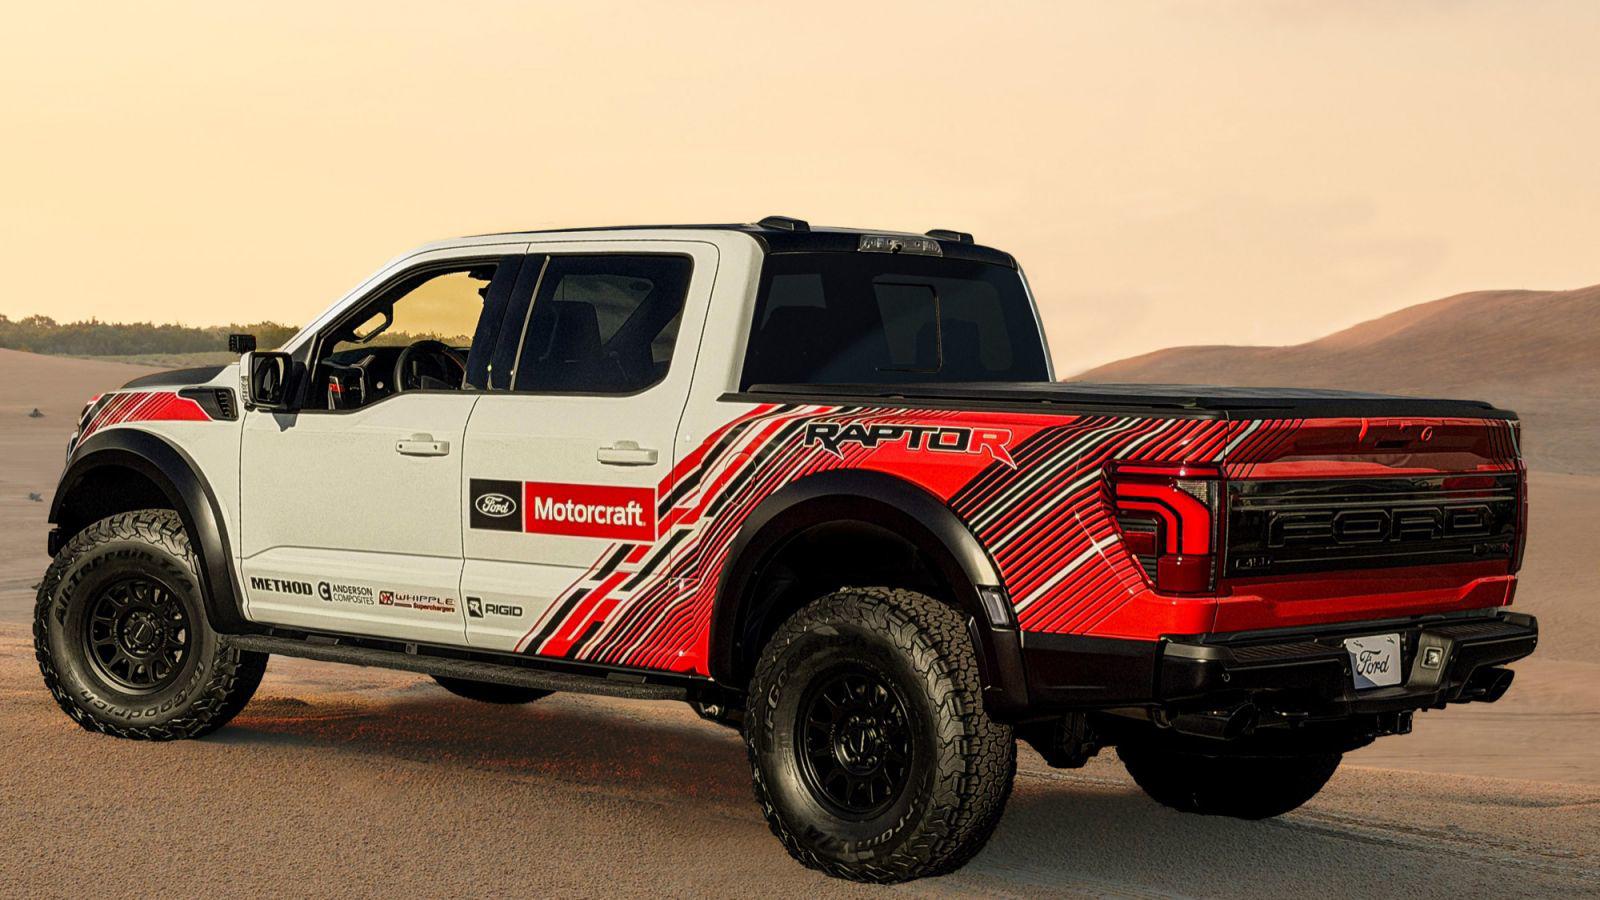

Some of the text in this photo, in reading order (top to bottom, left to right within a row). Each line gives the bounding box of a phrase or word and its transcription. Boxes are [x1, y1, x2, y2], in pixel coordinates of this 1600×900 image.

[803, 423, 1017, 470] RAPTOR
[482, 496, 509, 514] Ford
[1267, 503, 1495, 549] FORD
[250, 577, 313, 595] METHOD
[332, 584, 373, 597] ANDERSON
[333, 594, 375, 606] COMPOSITES
[395, 593, 455, 606] WHIPPLE
[413, 602, 455, 613] Superchargers
[485, 603, 523, 617] RIGID
[1356, 650, 1389, 675] Ford
